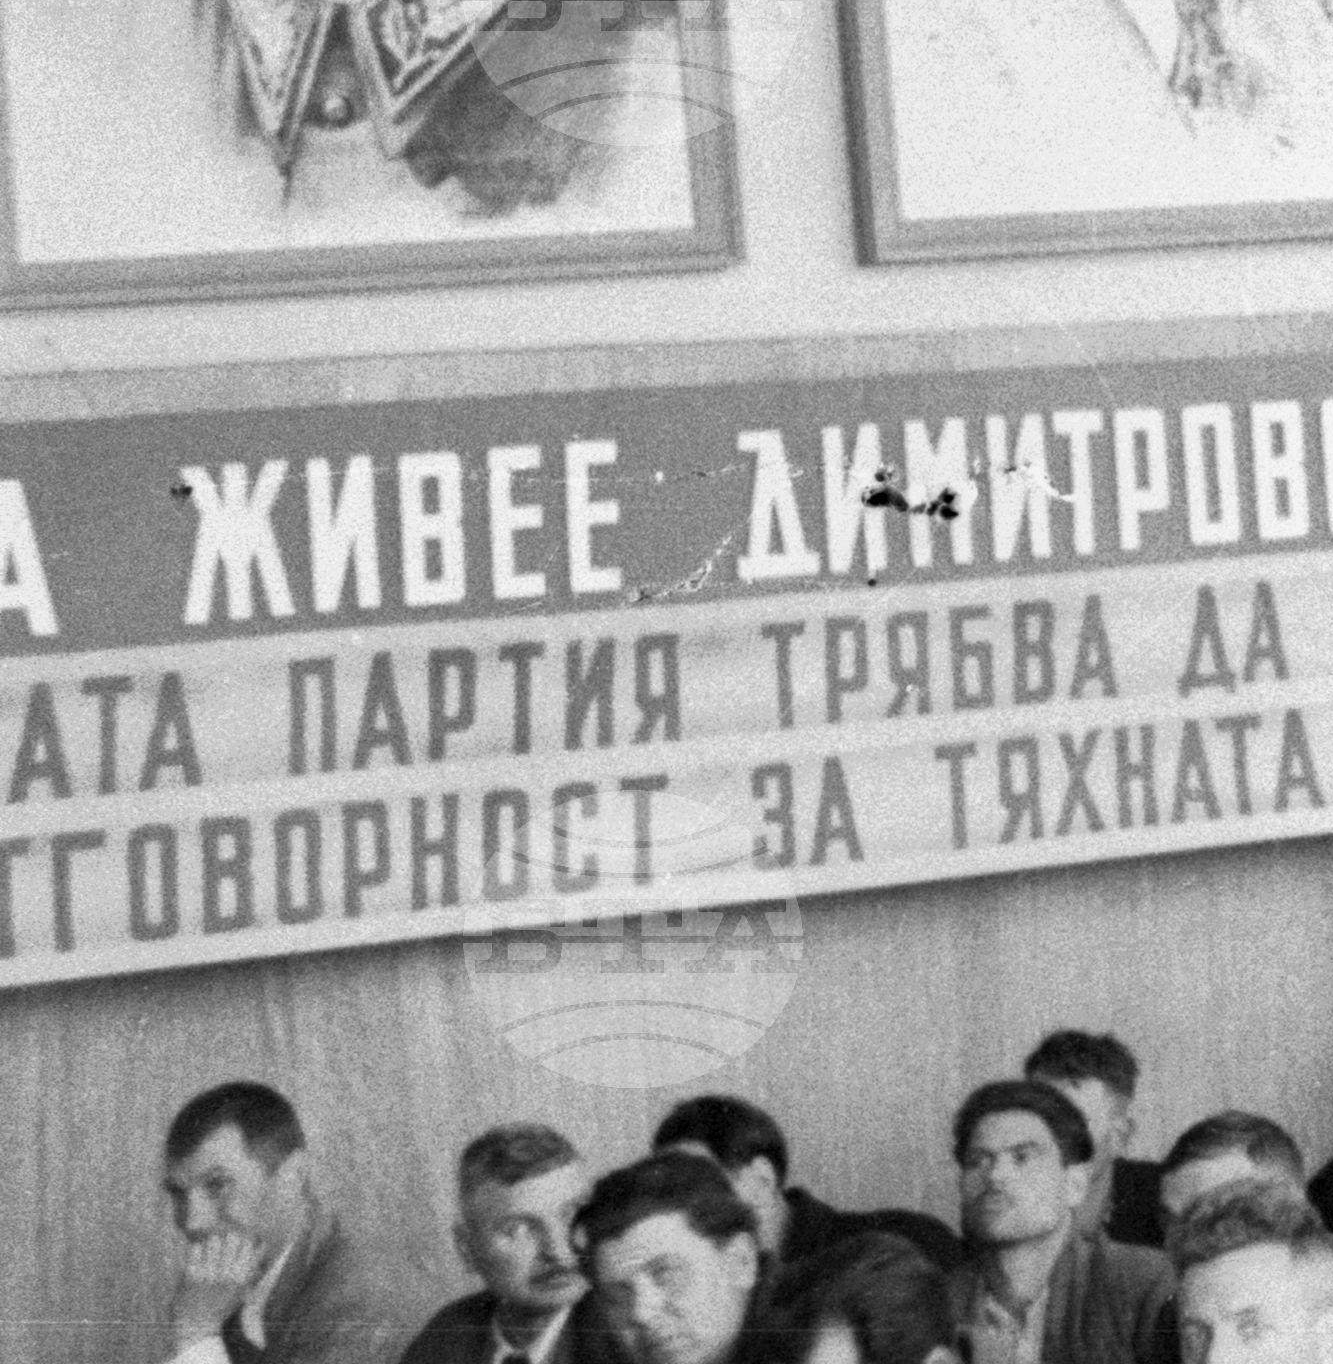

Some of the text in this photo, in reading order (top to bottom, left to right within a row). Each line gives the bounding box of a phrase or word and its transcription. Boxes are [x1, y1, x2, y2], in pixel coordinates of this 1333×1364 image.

[0, 479, 58, 635] А
[179, 439, 623, 625] ЖИВЕЕ
[6, 670, 201, 804] АТА
[287, 633, 683, 777] ПАРТИЯ
[762, 593, 1119, 730] ТРЯБВА
[1177, 580, 1290, 699] ДА
[751, 755, 863, 871] ЗА
[934, 708, 1326, 850] ТЯХНАТА
